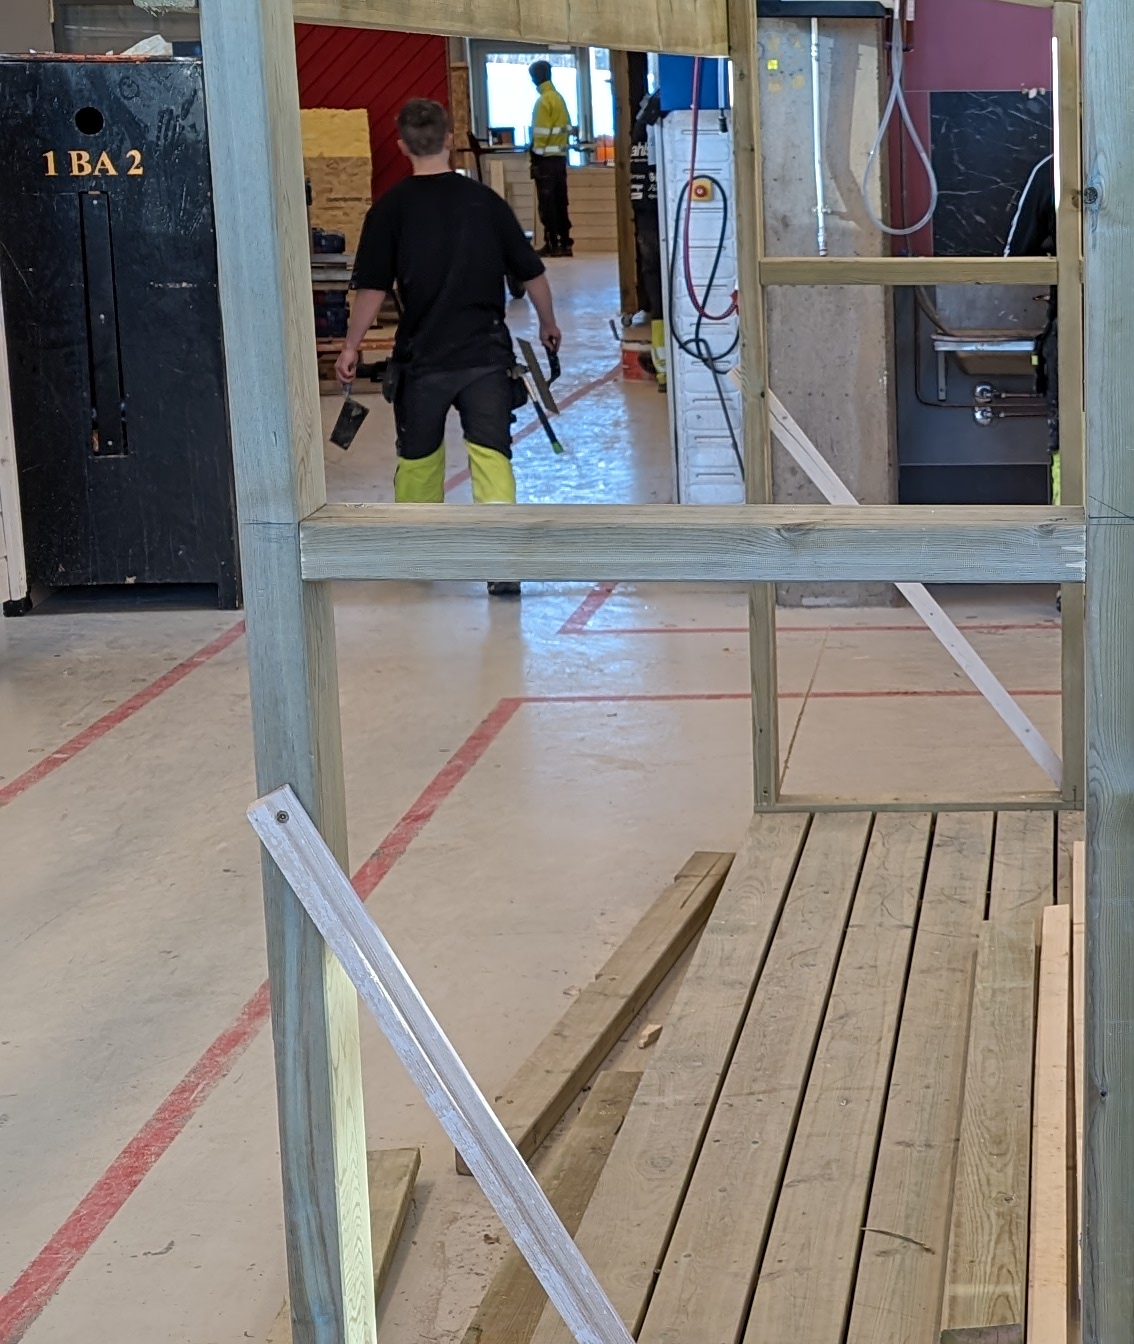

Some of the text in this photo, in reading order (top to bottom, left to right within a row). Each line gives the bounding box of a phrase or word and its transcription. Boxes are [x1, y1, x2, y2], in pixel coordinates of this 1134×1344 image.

[42, 149, 144, 176] 1 BA 2
